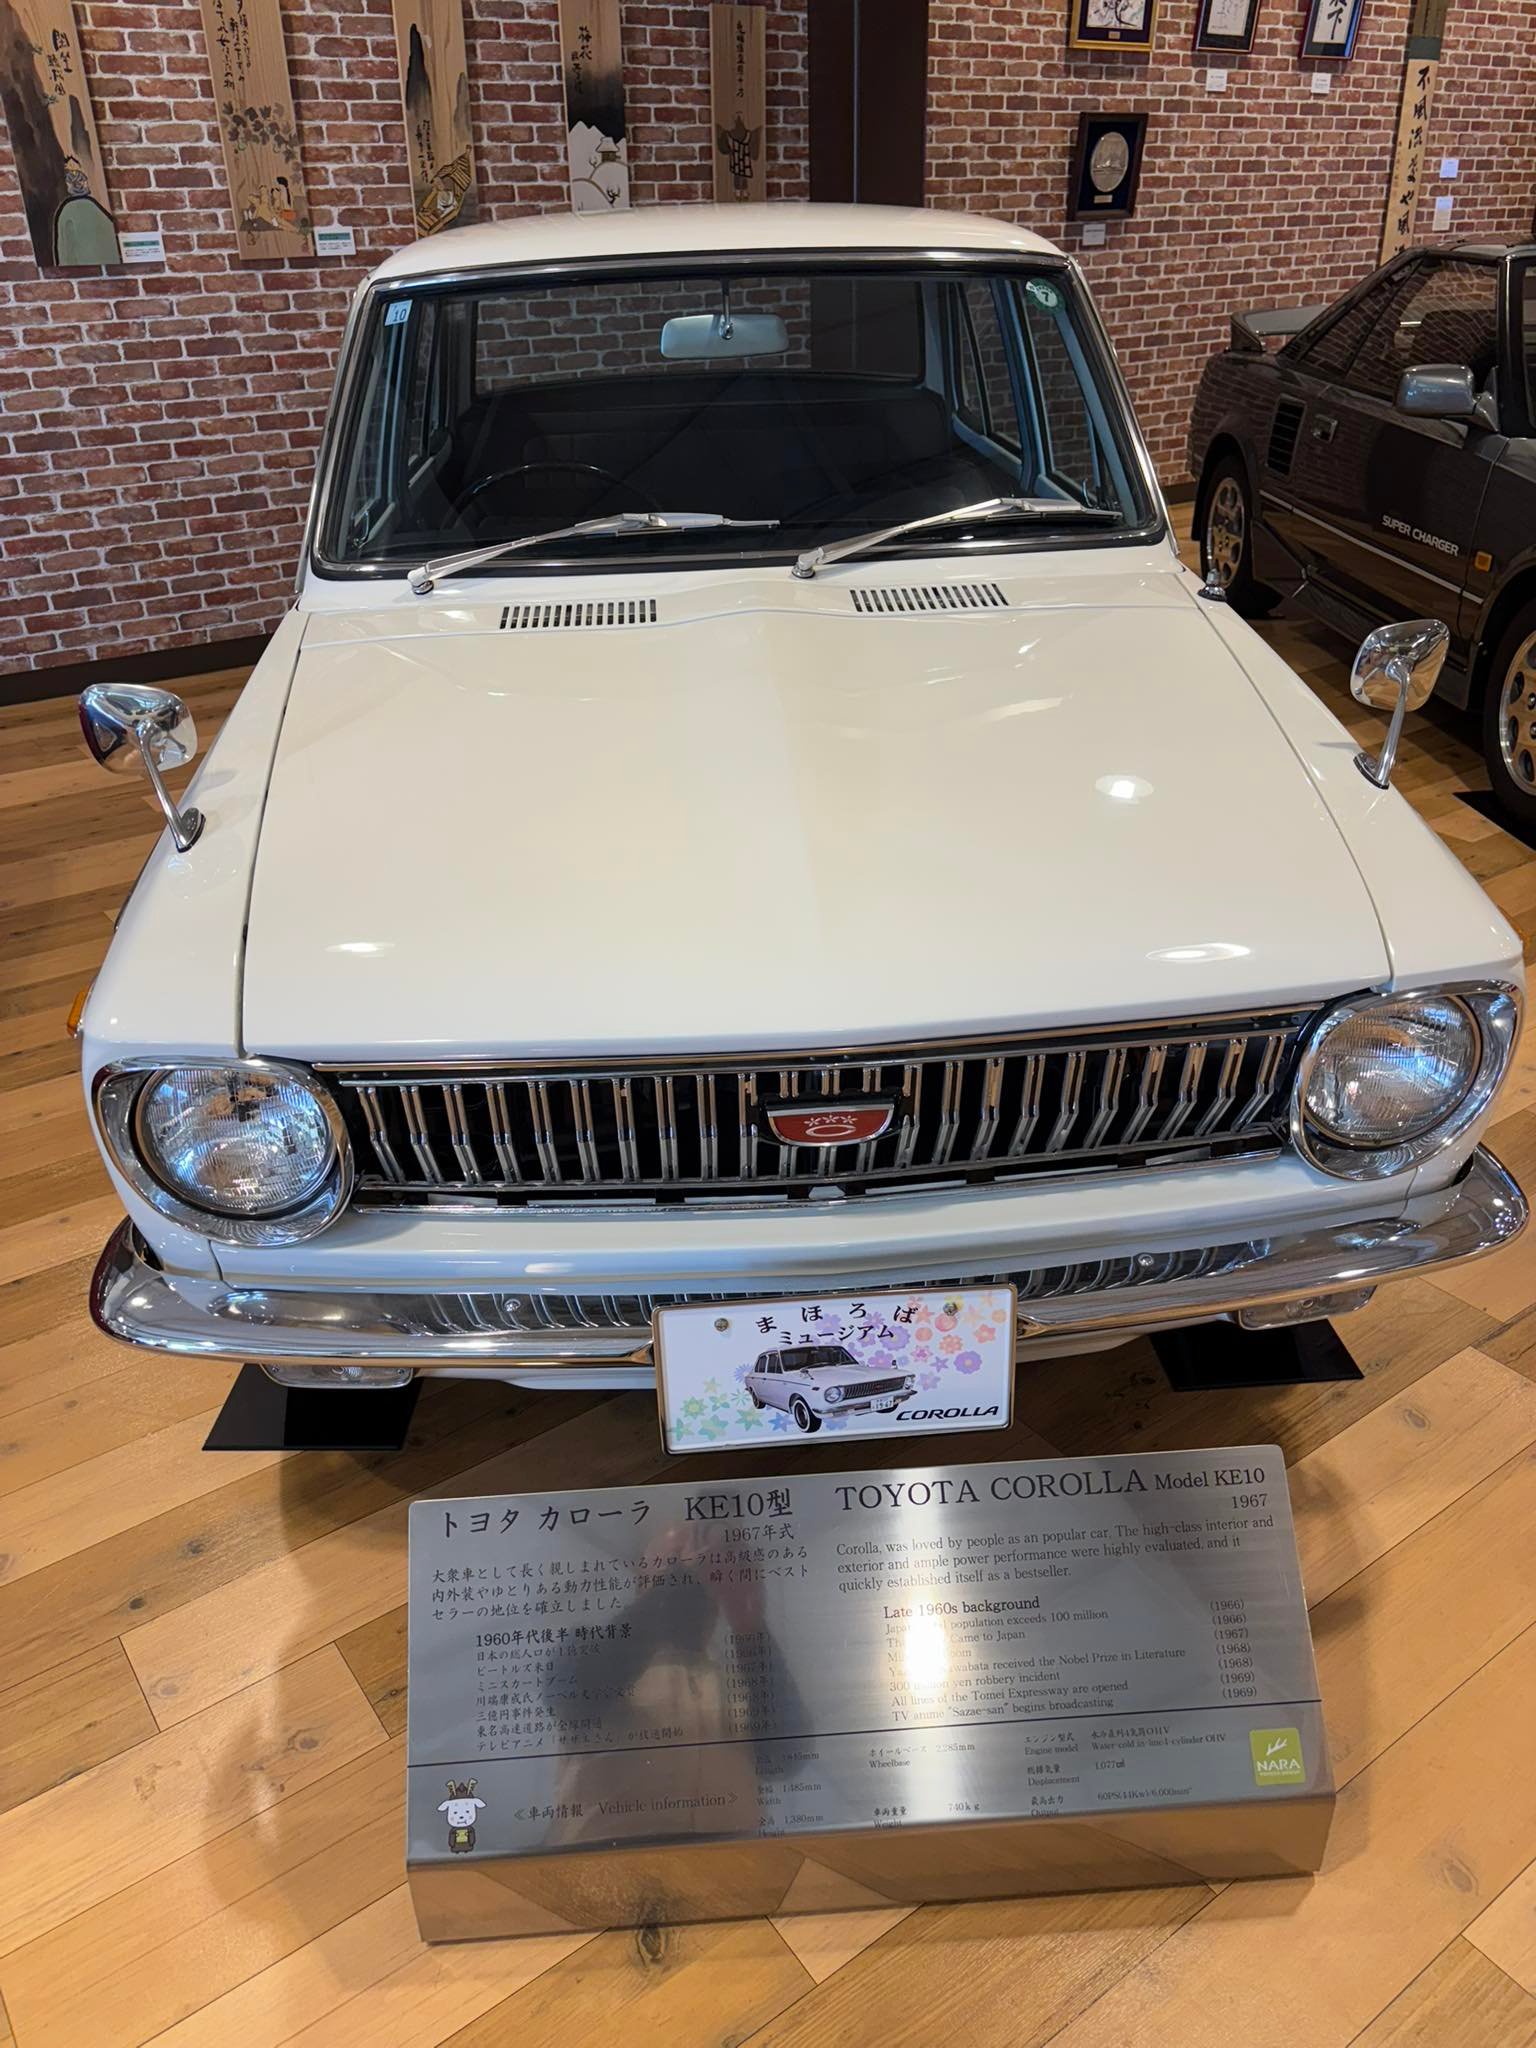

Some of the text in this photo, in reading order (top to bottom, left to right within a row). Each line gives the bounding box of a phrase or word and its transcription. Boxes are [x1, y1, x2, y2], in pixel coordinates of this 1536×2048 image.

[393, 309, 407, 322] 10
[1382, 515, 1459, 556] SUPER CHARGER
[778, 1325, 894, 1345] ミュージアム
[896, 1406, 999, 1421] COROLLA
[835, 1467, 1265, 1511] TOYOTA COROLLA Model KE10
[1232, 1493, 1267, 1509] 1967
[444, 1488, 793, 1538] トヨタ カローラ KE10型
[724, 1523, 794, 1543] 1967年式
[837, 1541, 882, 1556] Corolla,
[886, 1543, 908, 1553] was
[912, 1537, 943, 1551] loved
[948, 1536, 962, 1550] by
[967, 1533, 1004, 1549] people
[1008, 1534, 1021, 1544] as
[1024, 1534, 1039, 1544] an
[1043, 1526, 1086, 1544] popular
[1114, 1524, 1139, 1538] The
[1142, 1520, 1202, 1539] high-class
[1205, 1517, 1248, 1531] interior
[1252, 1514, 1273, 1529] and
[837, 1560, 884, 1574] exterior
[888, 1556, 909, 1570] and
[913, 1555, 949, 1570] ample
[953, 1554, 990, 1568] power
[994, 1547, 1067, 1566] performance
[1071, 1547, 1099, 1560] were
[1103, 1543, 1140, 1562] highly
[1207, 1536, 1228, 1549] and
[1231, 1535, 1241, 1547] it
[839, 1564, 1071, 1593] quickly established itself as a bestseller.
[884, 1595, 1041, 1619] Late 1960s background
[950, 1615, 1004, 1630] population
[1007, 1614, 1047, 1625] exceeds
[1050, 1611, 1070, 1622] 100
[1073, 1609, 1108, 1621] million
[1210, 1599, 1245, 1612] (1966)
[476, 1623, 632, 1647] 1960年代後半 時代背景
[983, 1632, 993, 1641] to
[997, 1630, 1026, 1643] Japan
[1214, 1627, 1249, 1640] (1967)
[993, 1656, 1036, 1669] received
[1039, 1657, 1055, 1668] the
[1059, 1653, 1089, 1665] Nobel
[1092, 1651, 1118, 1664] Prize
[1121, 1651, 1132, 1662] in
[1135, 1648, 1186, 1661] Literature
[1216, 1643, 1251, 1656] (1968)
[890, 1681, 909, 1692] 300
[976, 1675, 1015, 1688] robbery
[1019, 1671, 1060, 1683] incident
[1218, 1658, 1253, 1670] (1968)
[892, 1696, 908, 1707] All
[951, 1692, 968, 1703] the
[972, 1688, 1005, 1701] Tomei
[1008, 1684, 1069, 1699] Expressway
[1073, 1684, 1088, 1694] are
[1092, 1680, 1128, 1694] opened
[1220, 1671, 1255, 1684] (1969)
[892, 1711, 909, 1722] TV
[1012, 1701, 1046, 1714] begins
[1050, 1697, 1115, 1711] broadcasting
[1223, 1686, 1257, 1699] (1969)
[1024, 1745, 1052, 1756] Engine
[1055, 1743, 1079, 1753] model
[869, 1758, 911, 1769] Wheelbase
[1256, 1758, 1302, 1772] NARA
[599, 1800, 646, 1816] Vehicle
